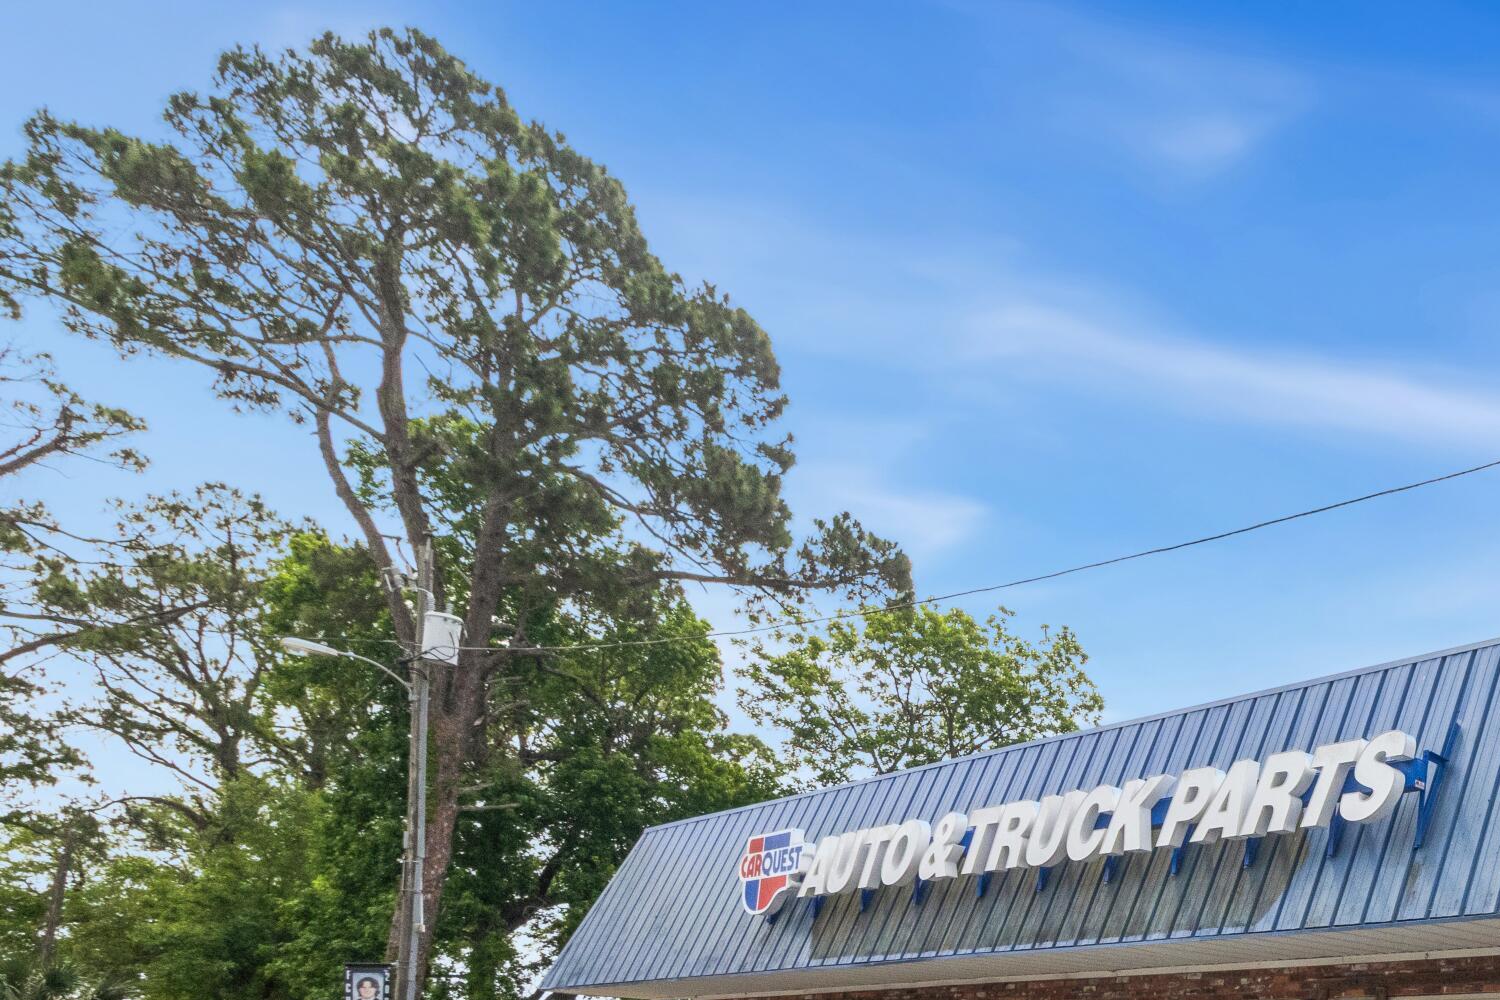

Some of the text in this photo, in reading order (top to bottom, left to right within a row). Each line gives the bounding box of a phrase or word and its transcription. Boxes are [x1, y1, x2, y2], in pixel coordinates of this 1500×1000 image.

[741, 846, 803, 879] CARQUEST
[797, 730, 1416, 897] AUTO & TRUCK PARTS
